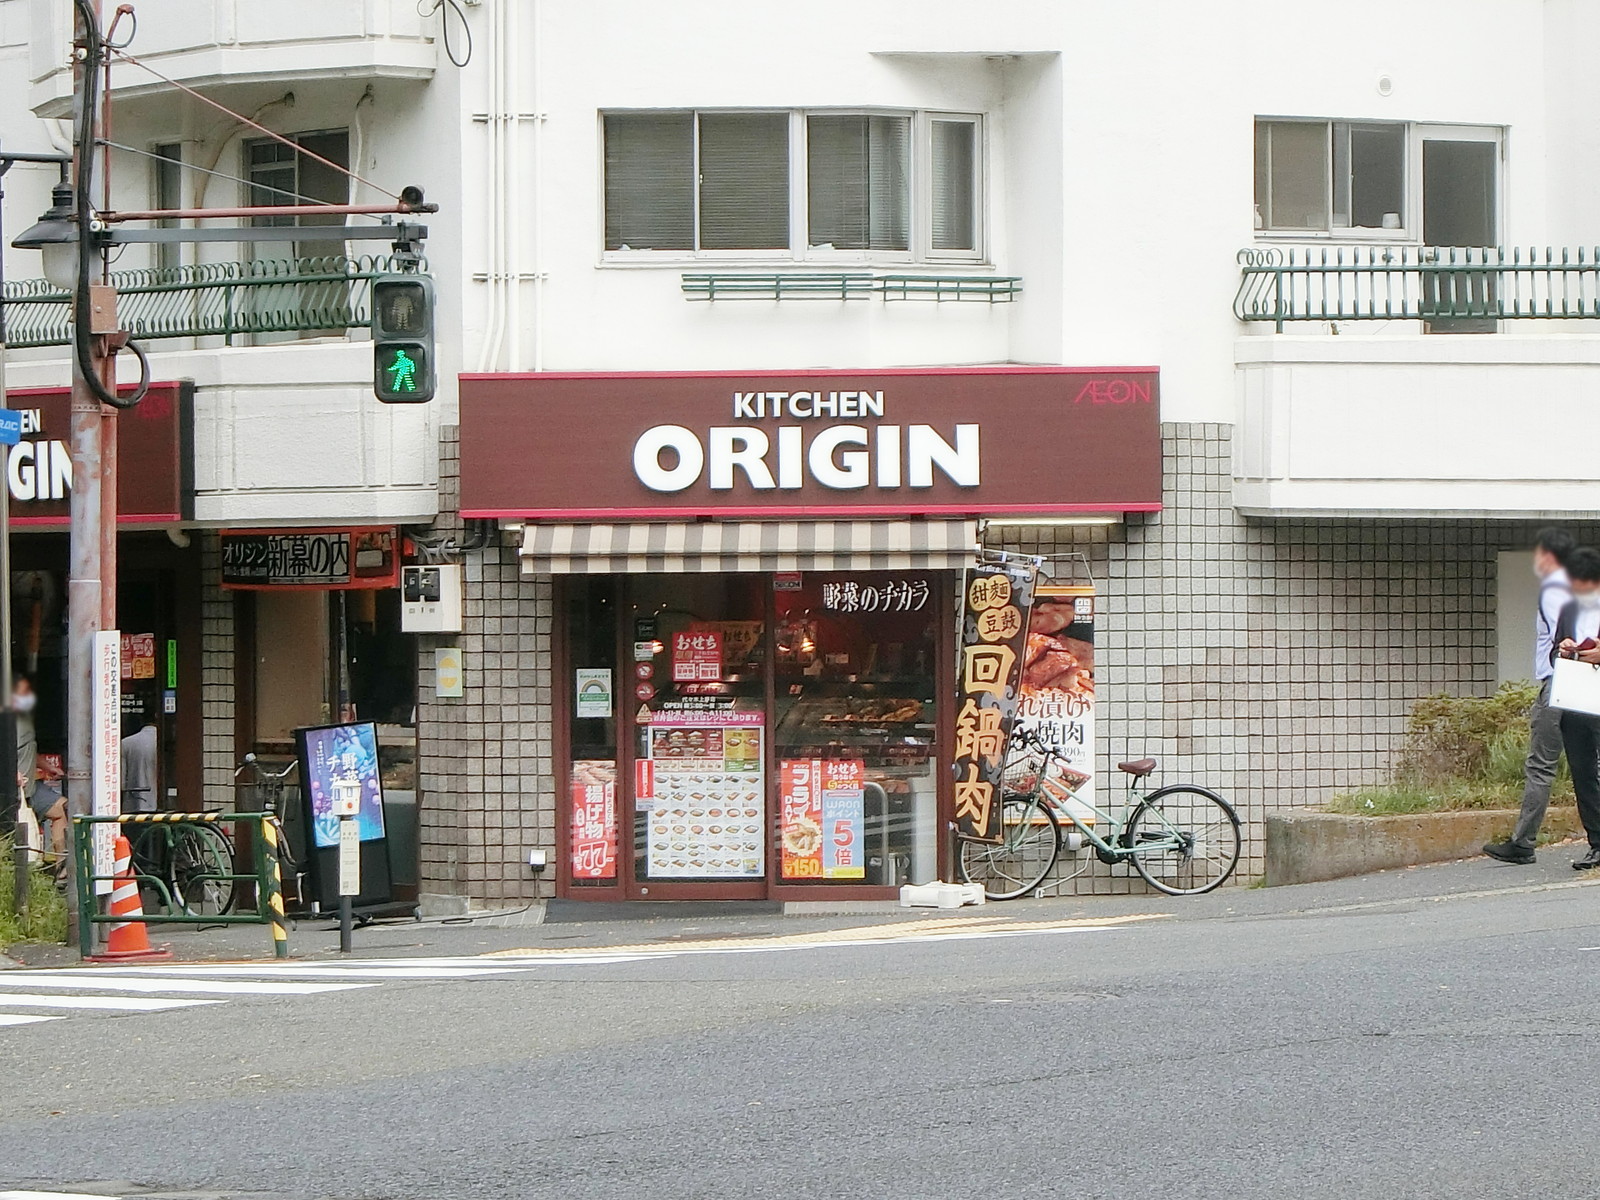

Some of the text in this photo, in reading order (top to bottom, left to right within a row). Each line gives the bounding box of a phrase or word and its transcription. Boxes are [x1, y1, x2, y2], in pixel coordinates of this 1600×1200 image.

[734, 391, 885, 419] KITCHEN
[633, 423, 980, 492] ORIGIN
[268, 534, 349, 577] 新幕の内
[822, 579, 930, 613] 野菜のチカラ
[677, 634, 717, 650] おせち
[955, 644, 1017, 837] 回鍋肉
[827, 762, 859, 775] おせち
[585, 784, 604, 839] 揚げ物
[785, 796, 793, 824] DAY
[826, 810, 859, 818] ポイント
[833, 820, 854, 847] 5
[835, 848, 852, 866] 倍
